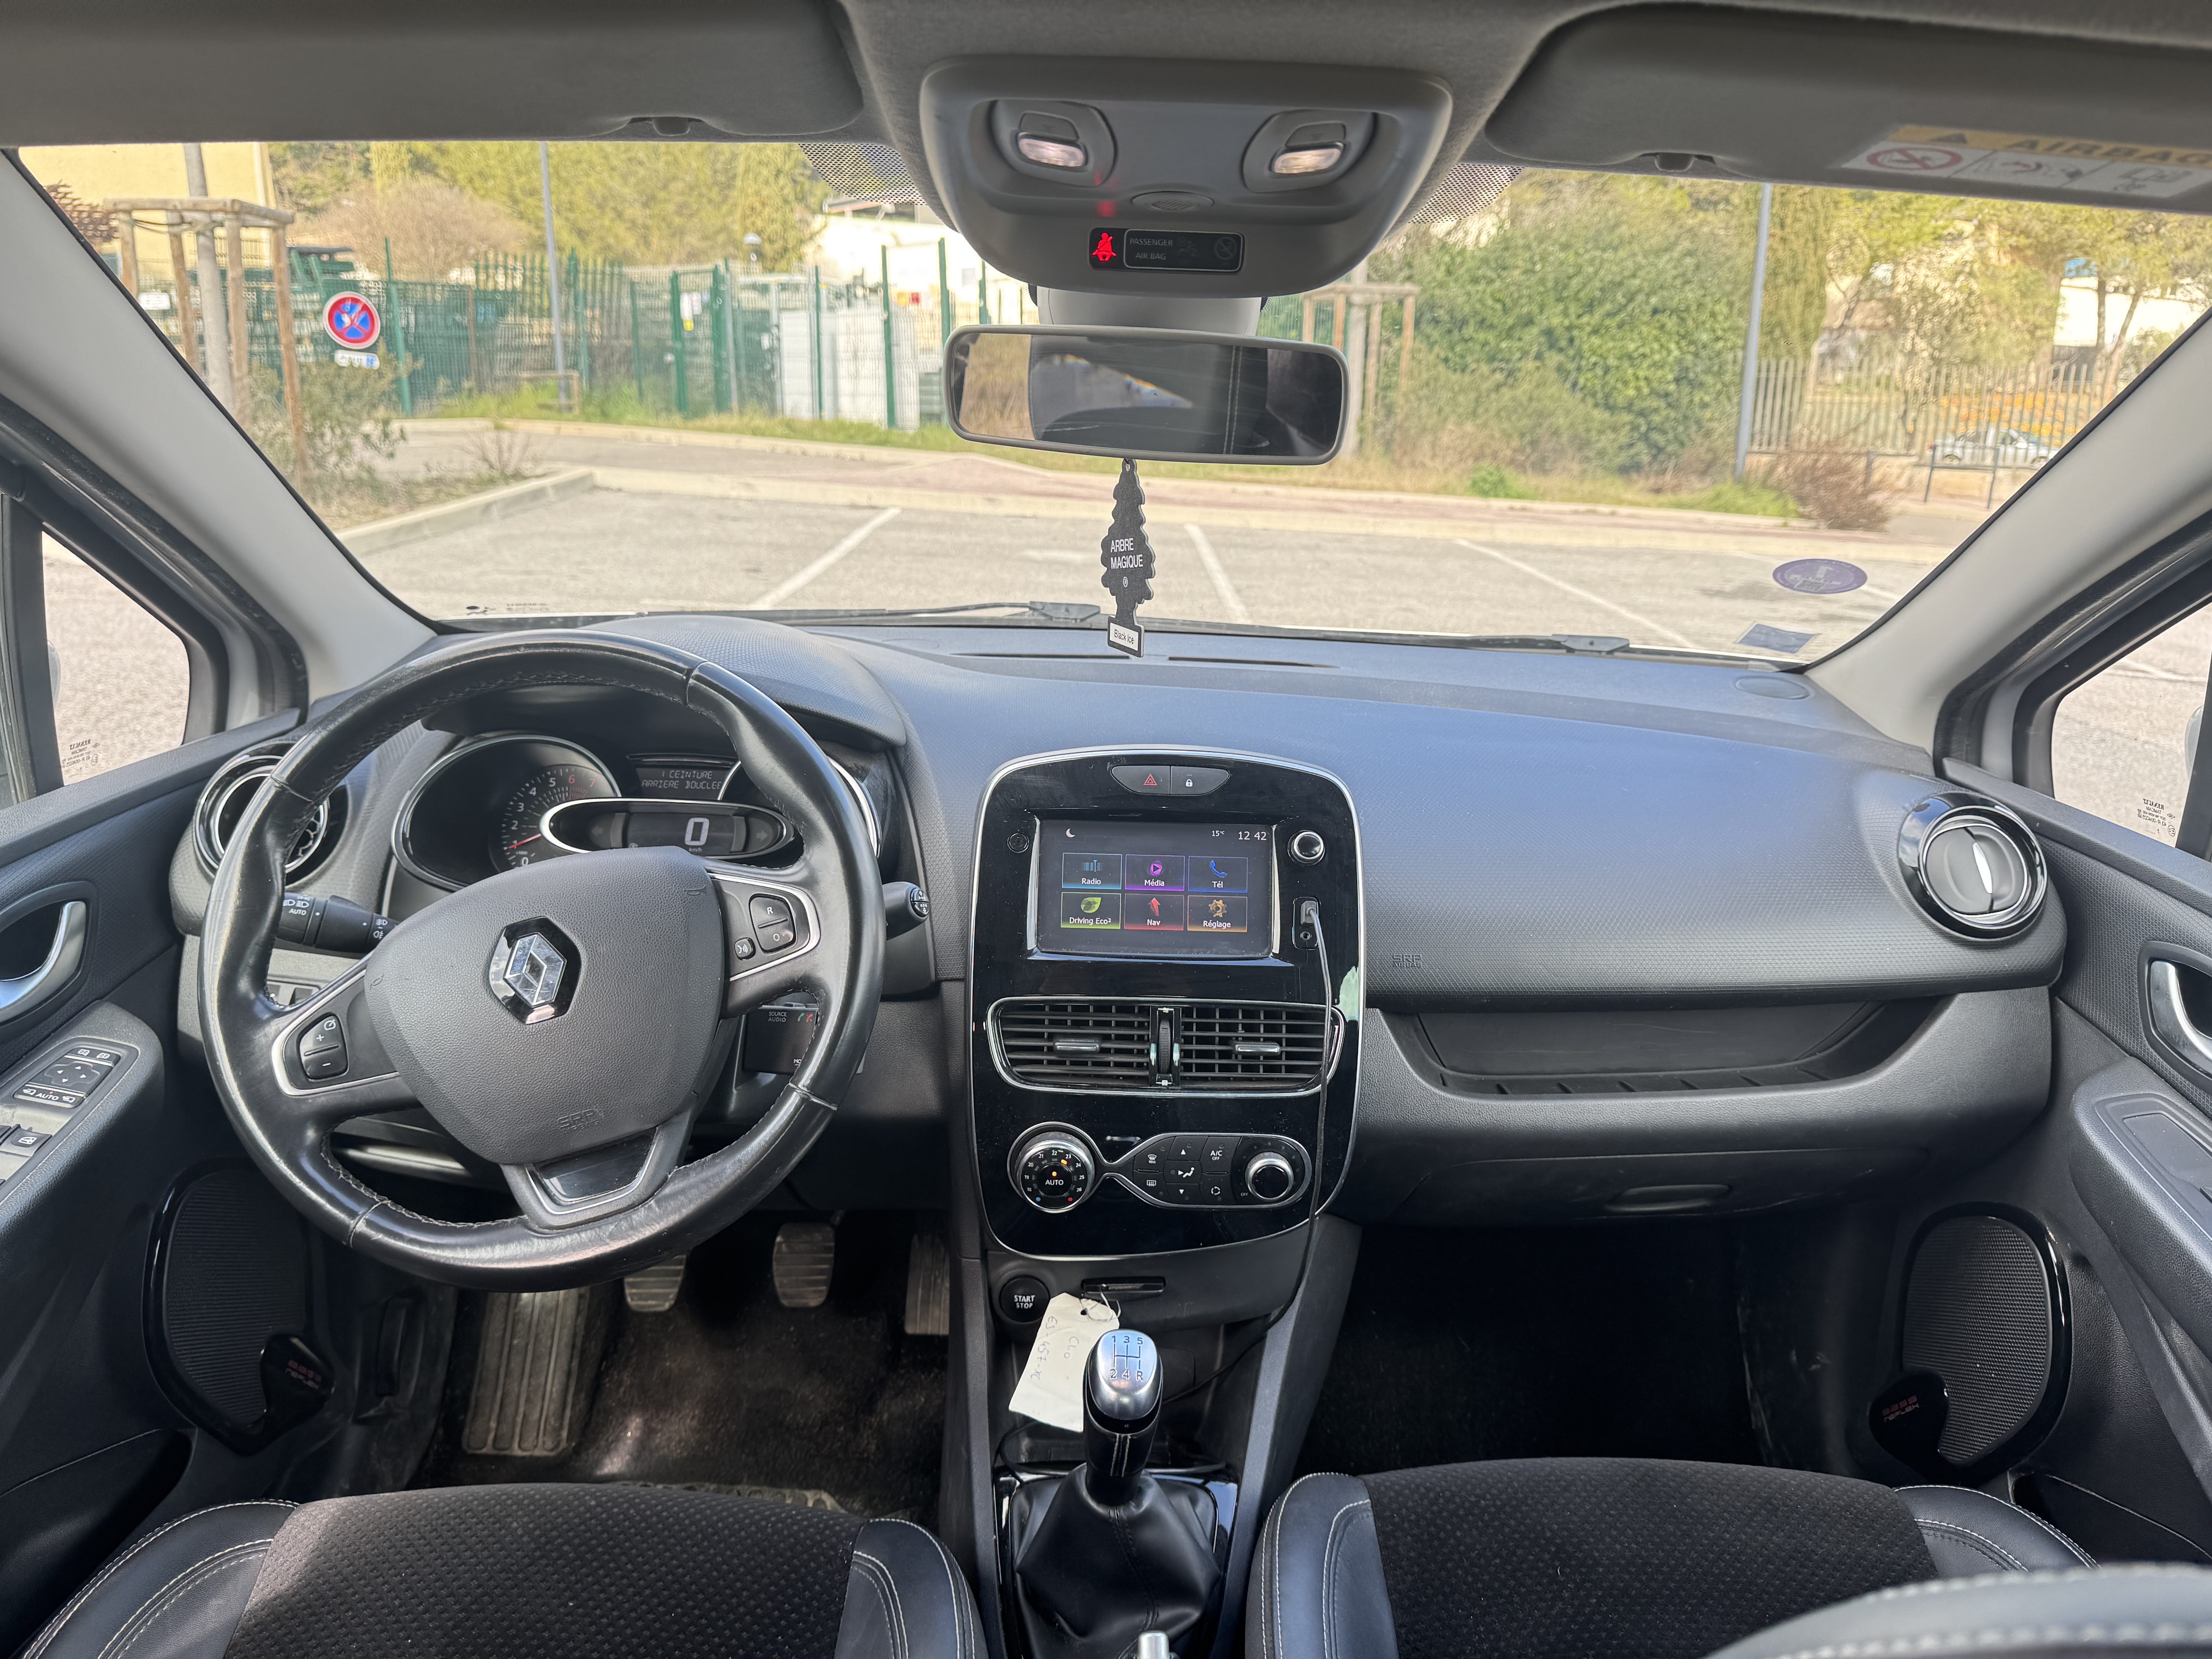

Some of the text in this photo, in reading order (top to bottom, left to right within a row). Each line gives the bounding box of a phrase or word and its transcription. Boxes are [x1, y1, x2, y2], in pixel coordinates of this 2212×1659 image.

[1130, 238, 1173, 246] PASSENGER
[1110, 538, 1134, 552] ARBRE
[1111, 554, 1143, 569] MAGIQUE
[1114, 629, 1127, 641] Black
[669, 770, 713, 779] CEINTURE
[549, 778, 556, 787] 5
[568, 775, 575, 784] 6
[589, 779, 596, 787] 7
[642, 780, 722, 789] ARRIERE BOUCLEE
[529, 787, 537, 796] 4
[517, 802, 524, 812] 3
[511, 820, 518, 830] 2
[685, 817, 709, 846] 0
[1238, 831, 1250, 840] 12
[1254, 832, 1267, 840] 42
[522, 857, 529, 866] 0
[767, 907, 773, 915] R
[1069, 917, 1094, 926] Driving
[1203, 920, 1231, 929] Réglage
[1064, 1336, 1079, 1358] Clio
[1110, 1369, 1143, 1381] 2 4 R
